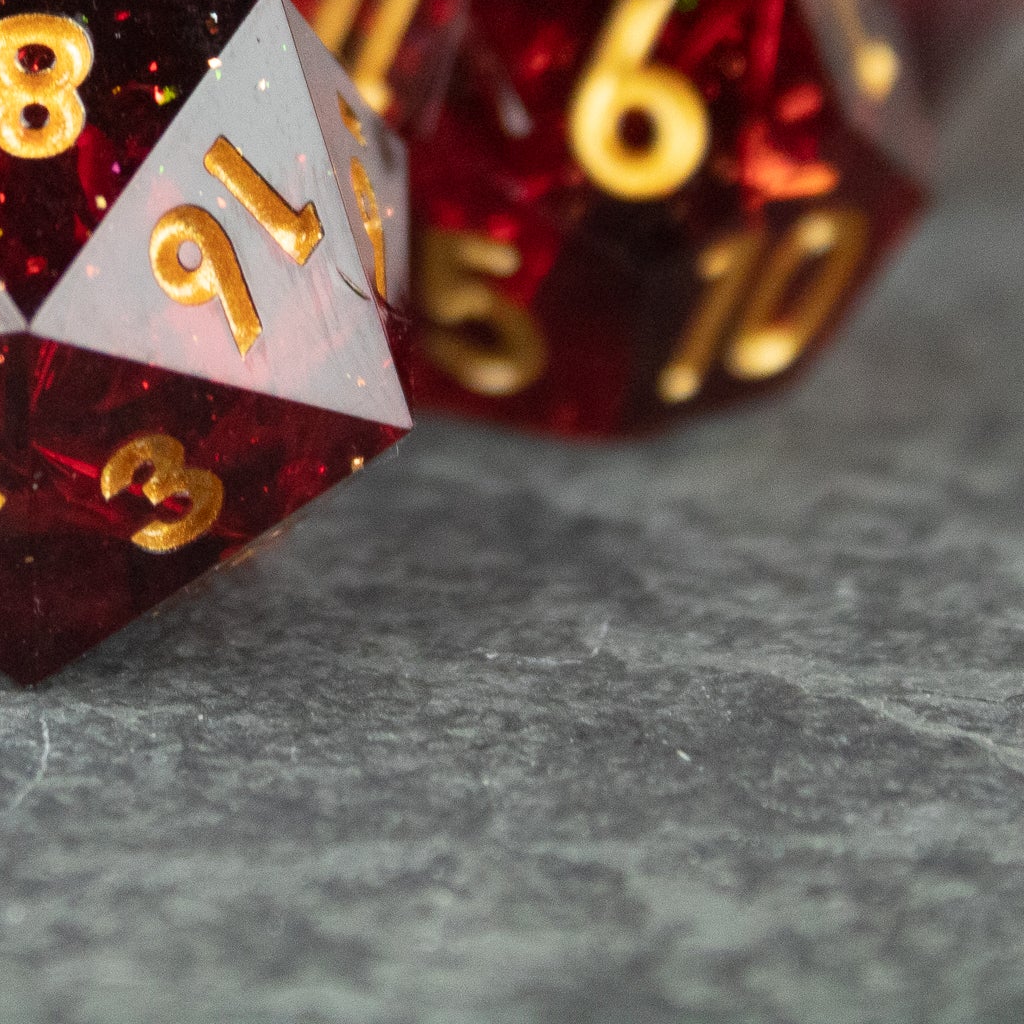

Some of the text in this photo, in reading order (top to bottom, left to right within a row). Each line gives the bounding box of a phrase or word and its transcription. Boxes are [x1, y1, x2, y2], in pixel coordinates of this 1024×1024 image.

[416, 227, 546, 396] 5
[659, 206, 868, 404] 10
[101, 434, 225, 553] 3
